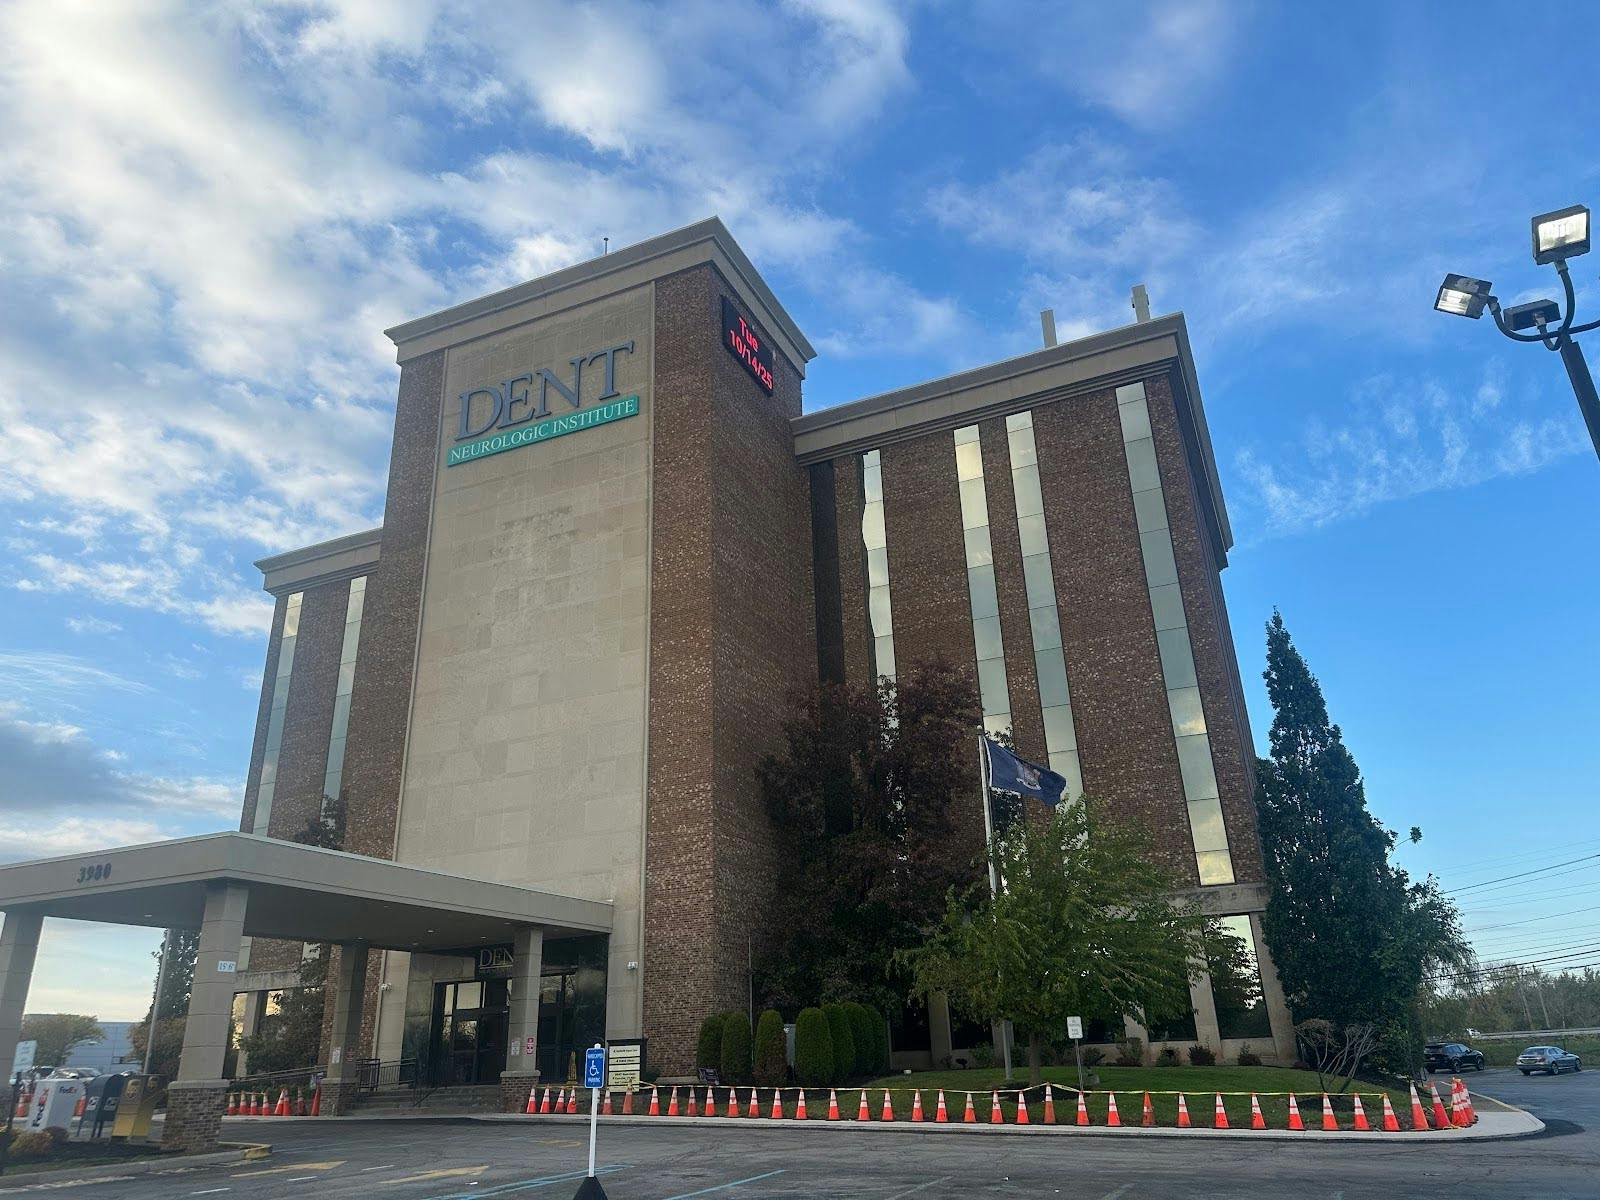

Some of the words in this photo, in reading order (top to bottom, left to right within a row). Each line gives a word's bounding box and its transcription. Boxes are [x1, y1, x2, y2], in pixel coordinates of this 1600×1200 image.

[738, 316, 758, 352] Tue
[729, 329, 773, 390] 10/14/25
[455, 341, 634, 441] DENT
[450, 423, 550, 461] NEUROLOGIC
[552, 399, 634, 434] INSTITUTE
[76, 862, 112, 882] 3980
[478, 948, 514, 966] DEN
